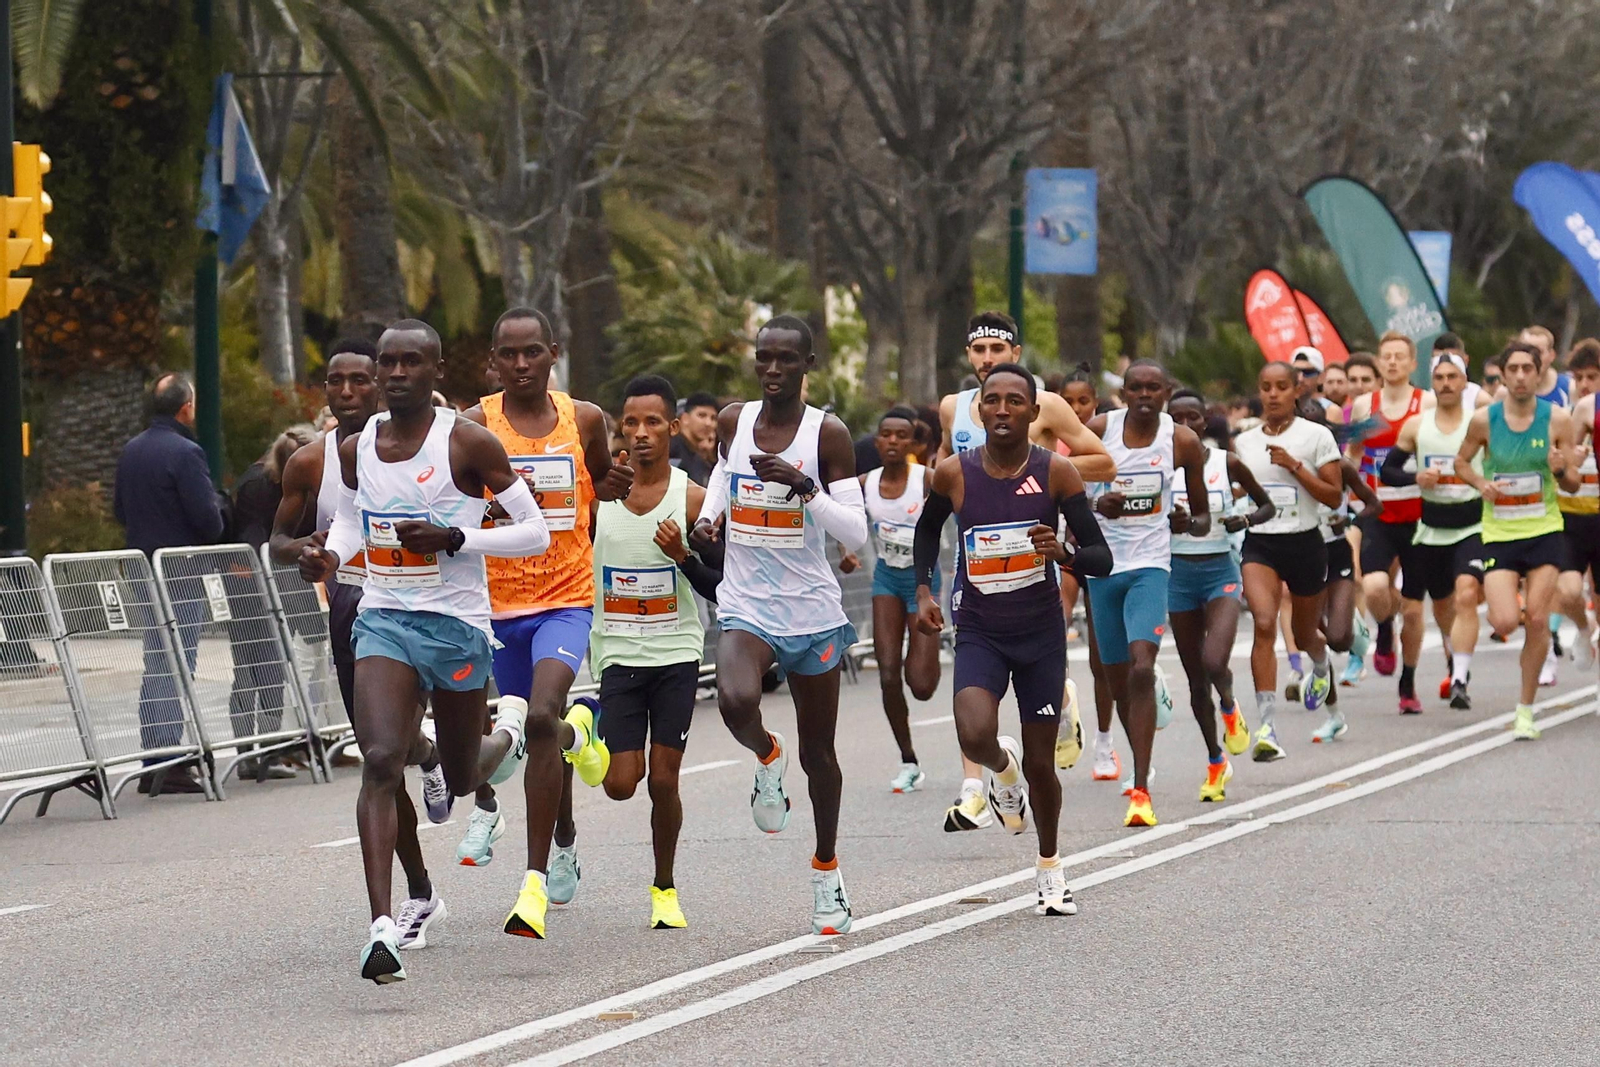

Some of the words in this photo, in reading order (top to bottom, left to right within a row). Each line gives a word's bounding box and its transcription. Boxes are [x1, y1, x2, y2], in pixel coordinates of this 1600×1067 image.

[1123, 498, 1153, 510] ACER
[761, 510, 769, 527] 1
[391, 548, 403, 566] 9
[999, 556, 1011, 573] 7
[637, 600, 648, 615] 5
